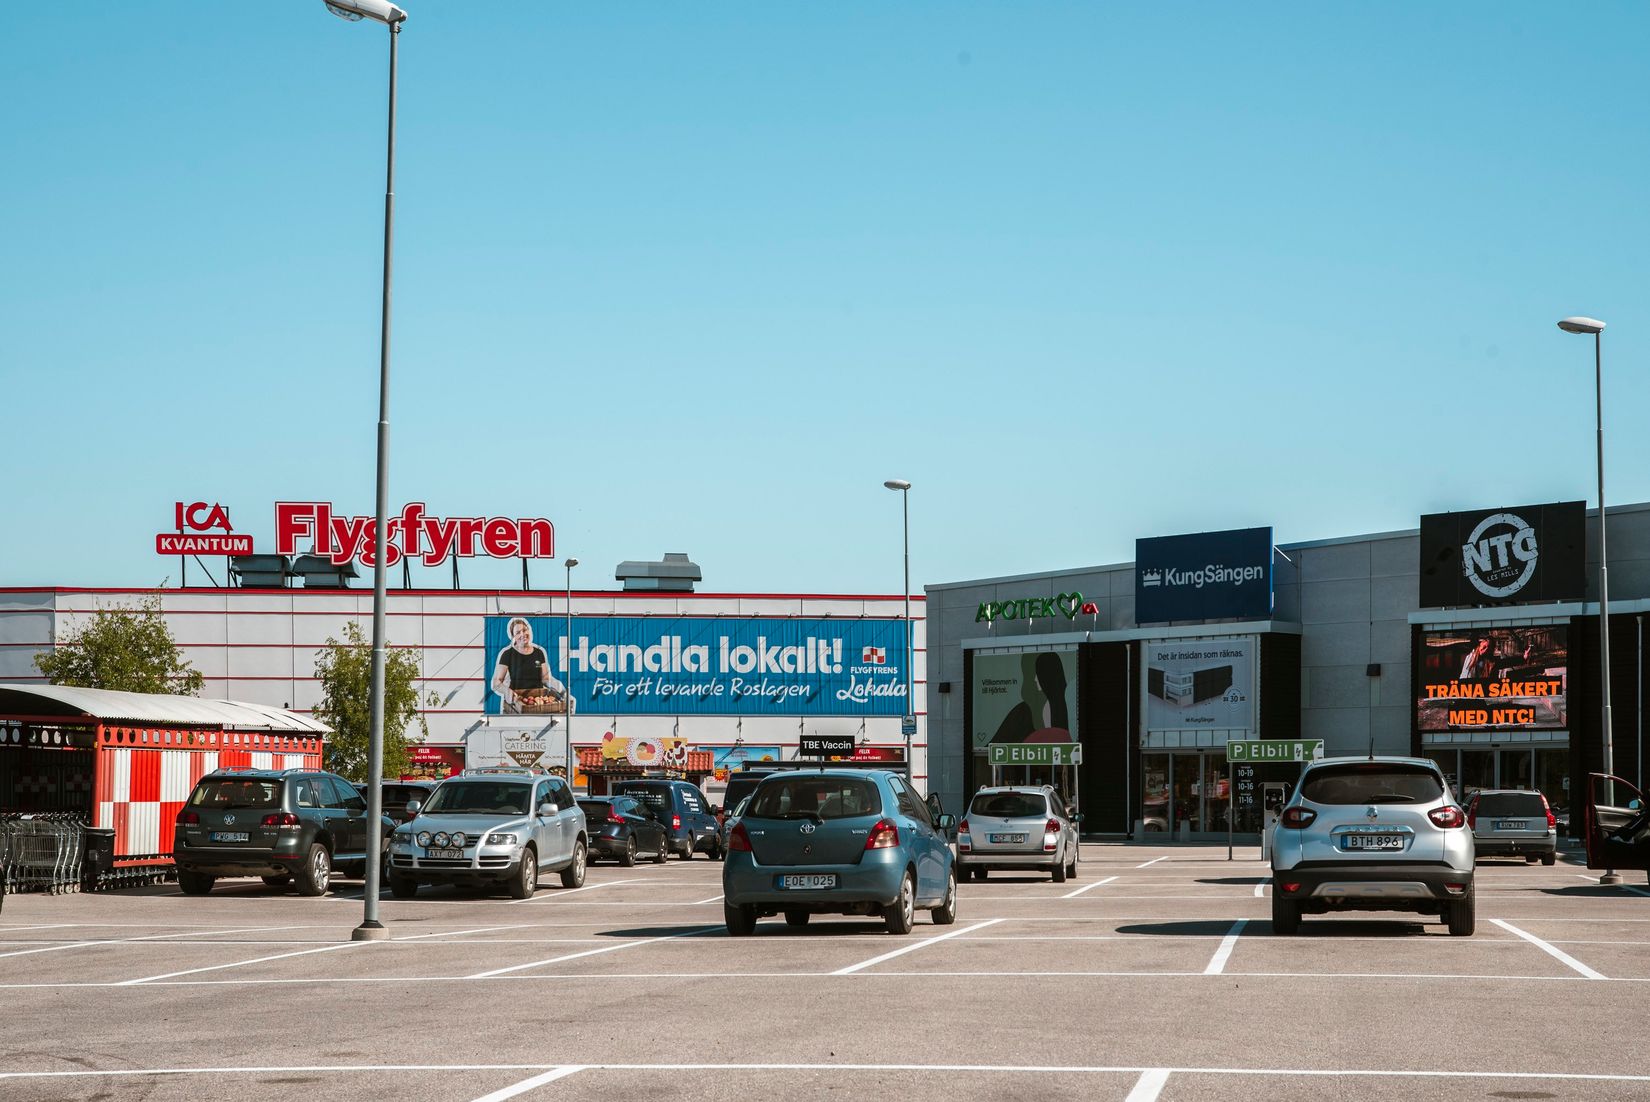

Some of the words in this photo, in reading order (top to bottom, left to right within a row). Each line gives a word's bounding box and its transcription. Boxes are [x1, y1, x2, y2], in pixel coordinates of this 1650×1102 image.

[175, 501, 234, 531] ICA
[275, 501, 555, 567] Flygfyren
[161, 537, 249, 551] KVANTUM
[1462, 527, 1539, 577] NTC
[1165, 564, 1263, 588] KungSängen
[975, 597, 1056, 623] APOTEK
[558, 635, 709, 673] Handla
[719, 635, 843, 674] lokalt!
[1157, 652, 1169, 660] Det
[1170, 652, 1177, 660] är
[1178, 650, 1201, 660] insidan
[1203, 650, 1218, 659] som
[1219, 648, 1244, 658] räknas.
[850, 666, 898, 674] FLYGFYRENS
[592, 677, 623, 695] För
[625, 676, 652, 696] ett
[655, 676, 725, 696] levande
[730, 677, 810, 703] Roslagen
[836, 674, 907, 703] Lokala
[1425, 681, 1485, 699] TRÄNA
[1488, 679, 1561, 697] SÄKERT
[1449, 710, 1488, 725] MED
[1492, 709, 1535, 724] NTC!
[504, 742, 547, 750] CATERING
[802, 740, 820, 749] TBE
[822, 740, 852, 749] Vaccin
[1234, 745, 1243, 757] P
[1251, 744, 1288, 757] Elbil
[995, 748, 1004, 760] P
[1012, 748, 1047, 760] Elbil
[1238, 769, 1254, 777] 10-19
[1238, 796, 1253, 804] 11-16
[1351, 836, 1373, 846] BTH
[1377, 836, 1399, 846] 896
[785, 876, 805, 886] EOE
[813, 876, 834, 886] 025
